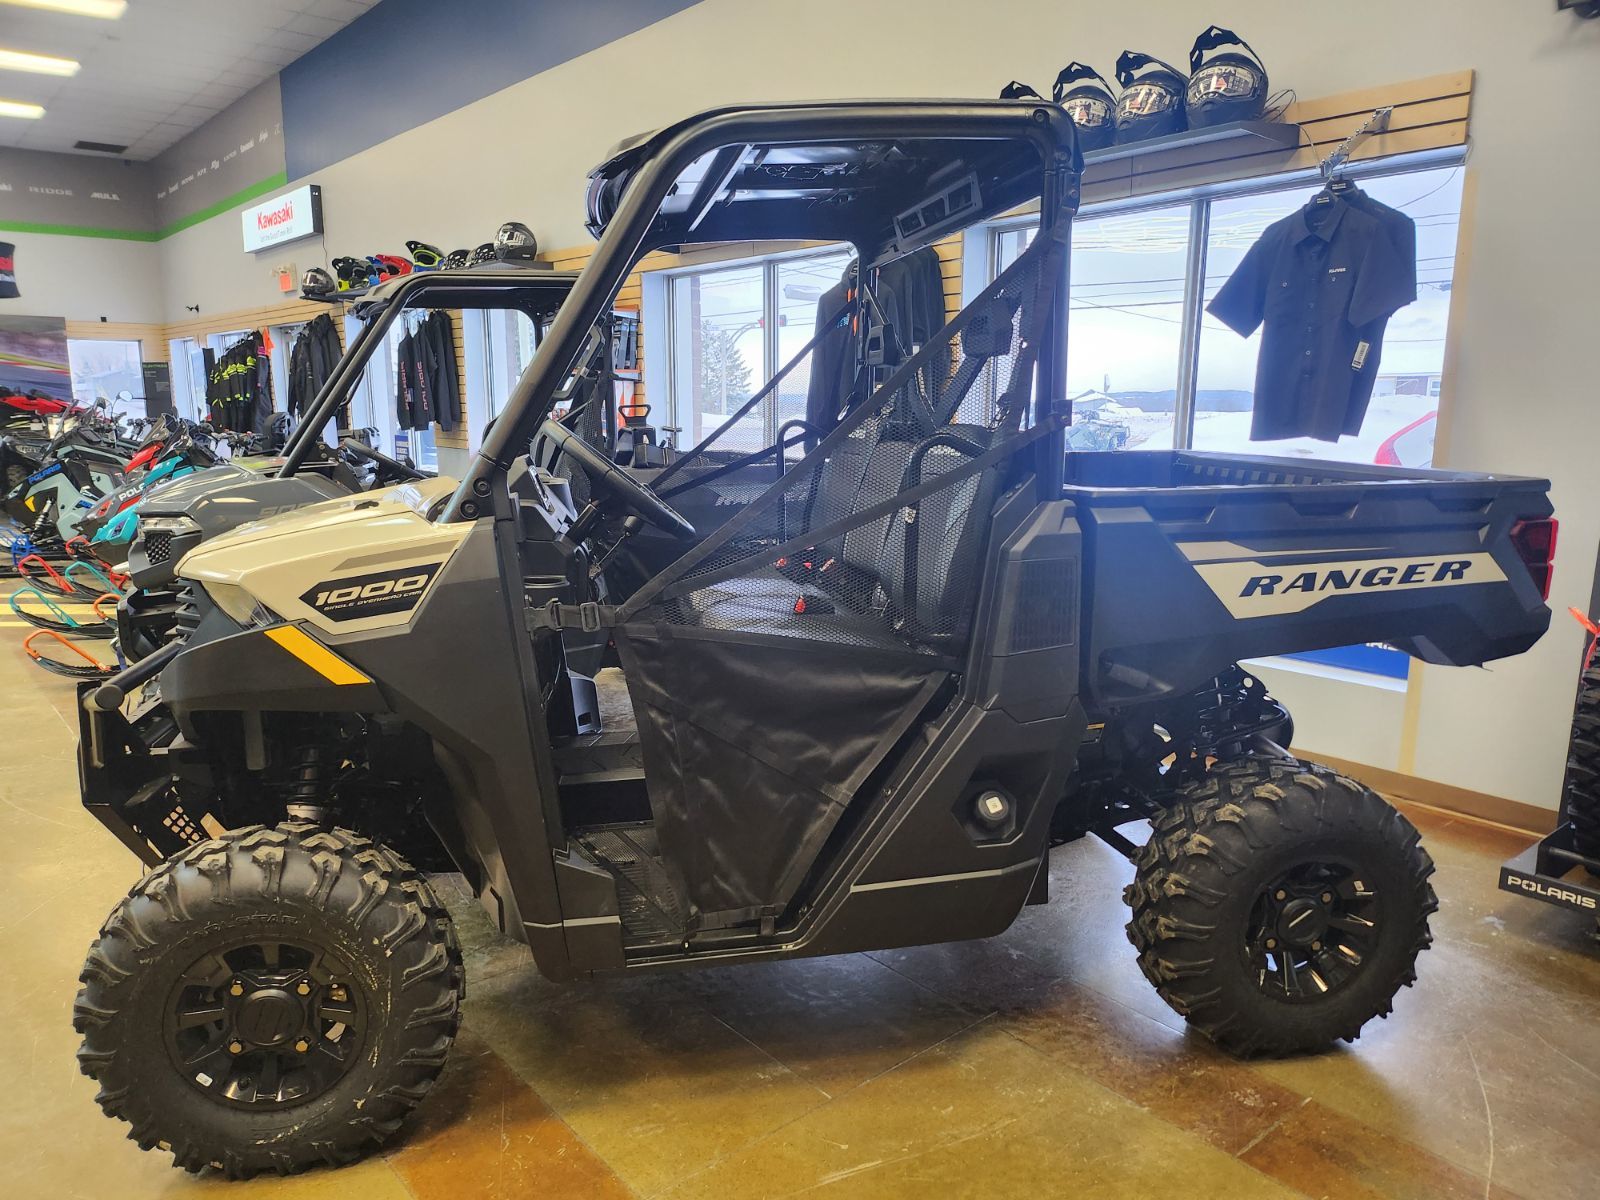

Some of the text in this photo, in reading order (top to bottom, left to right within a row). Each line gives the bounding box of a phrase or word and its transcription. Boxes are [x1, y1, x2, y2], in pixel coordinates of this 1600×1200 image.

[90, 191, 121, 201] MULE
[257, 200, 294, 231] Kawasaki
[28, 463, 62, 485] POLARIS
[315, 574, 429, 606] 1000
[1238, 560, 1472, 598] RANGER
[323, 590, 423, 611] SINGLE OVERHEAD CAM
[1507, 875, 1596, 909] POLARIS
